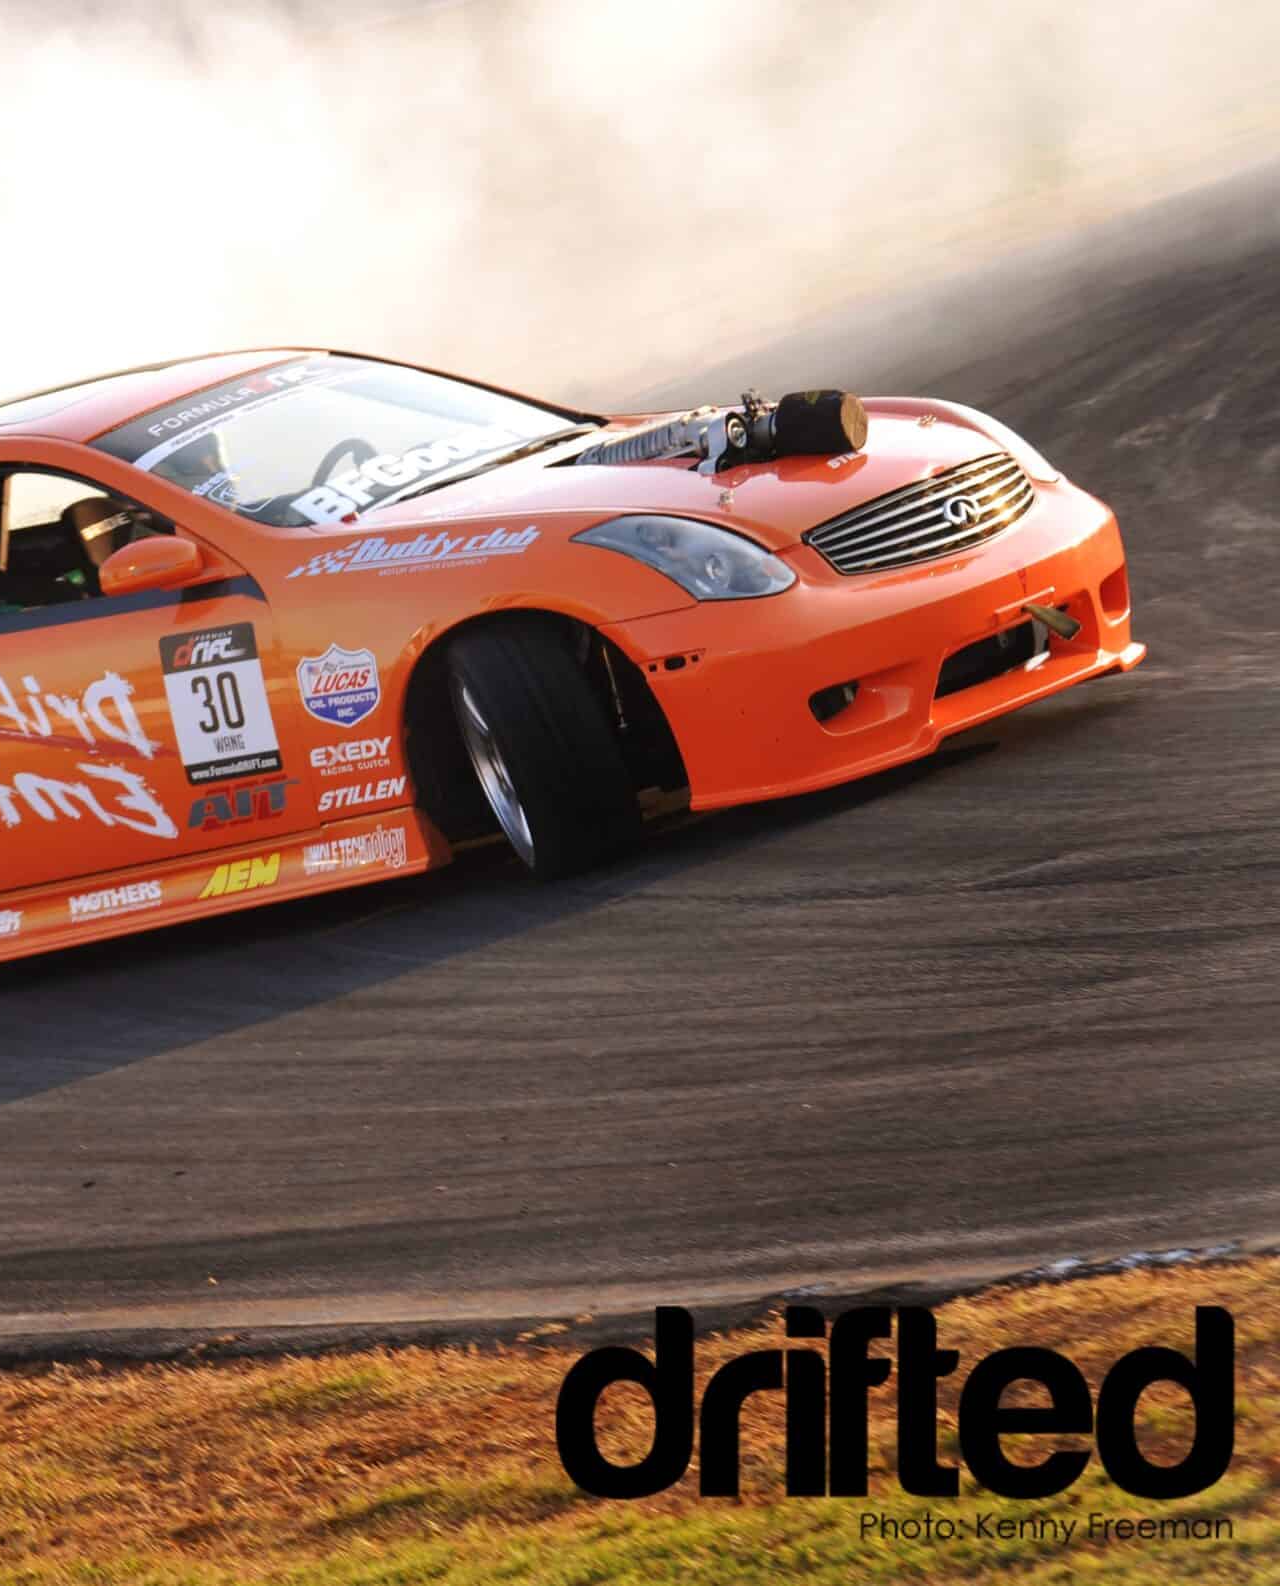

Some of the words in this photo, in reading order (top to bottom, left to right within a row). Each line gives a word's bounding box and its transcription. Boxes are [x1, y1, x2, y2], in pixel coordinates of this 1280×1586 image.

[352, 531, 464, 561] Buddy
[463, 525, 542, 552] club
[311, 668, 370, 695] LUCAS
[191, 671, 245, 733] 30
[309, 698, 327, 709] OIL
[328, 690, 377, 707] PRODUCTS
[214, 733, 246, 753] WANG
[310, 735, 392, 768] EXEDY
[318, 775, 407, 812] STILLEN
[199, 853, 281, 900] AEM
[69, 879, 163, 914] MOTHERS
